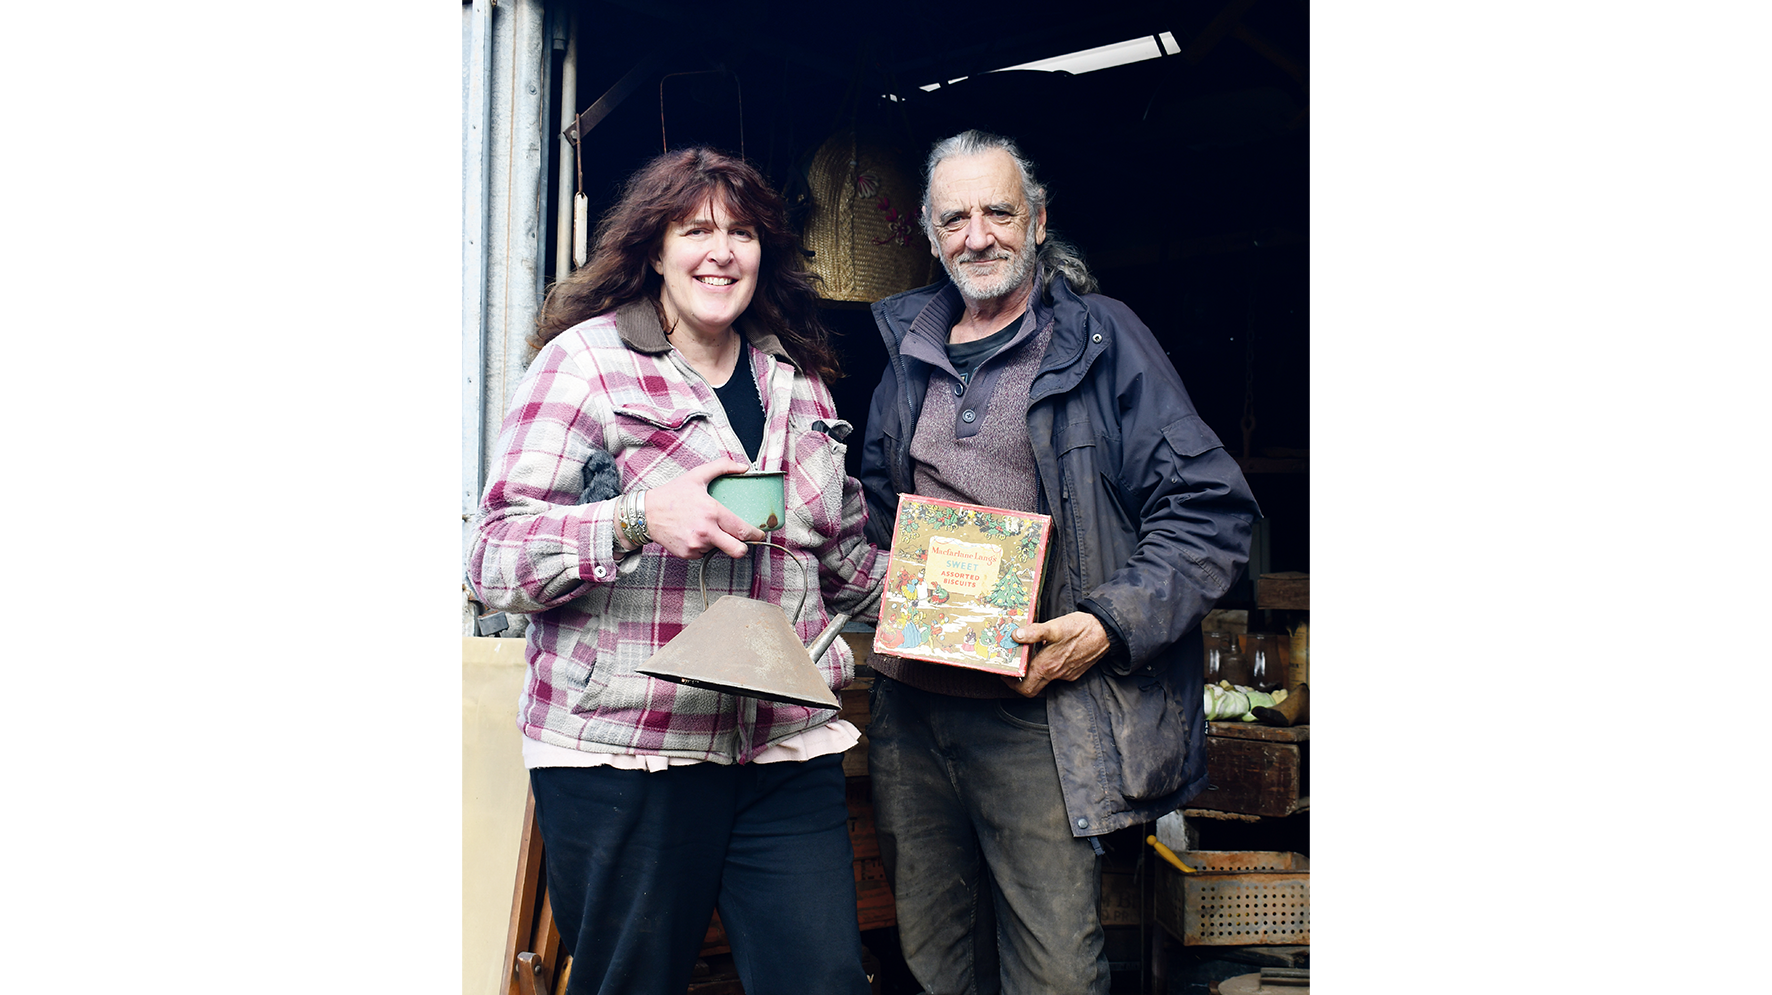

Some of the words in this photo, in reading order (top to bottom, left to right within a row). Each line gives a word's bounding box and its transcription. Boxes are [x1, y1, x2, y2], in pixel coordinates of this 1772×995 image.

[932, 546, 973, 559] Macfarlane
[946, 560, 979, 571] SWEET
[941, 570, 980, 580] ASSORTED
[943, 578, 976, 587] BISCUITS
